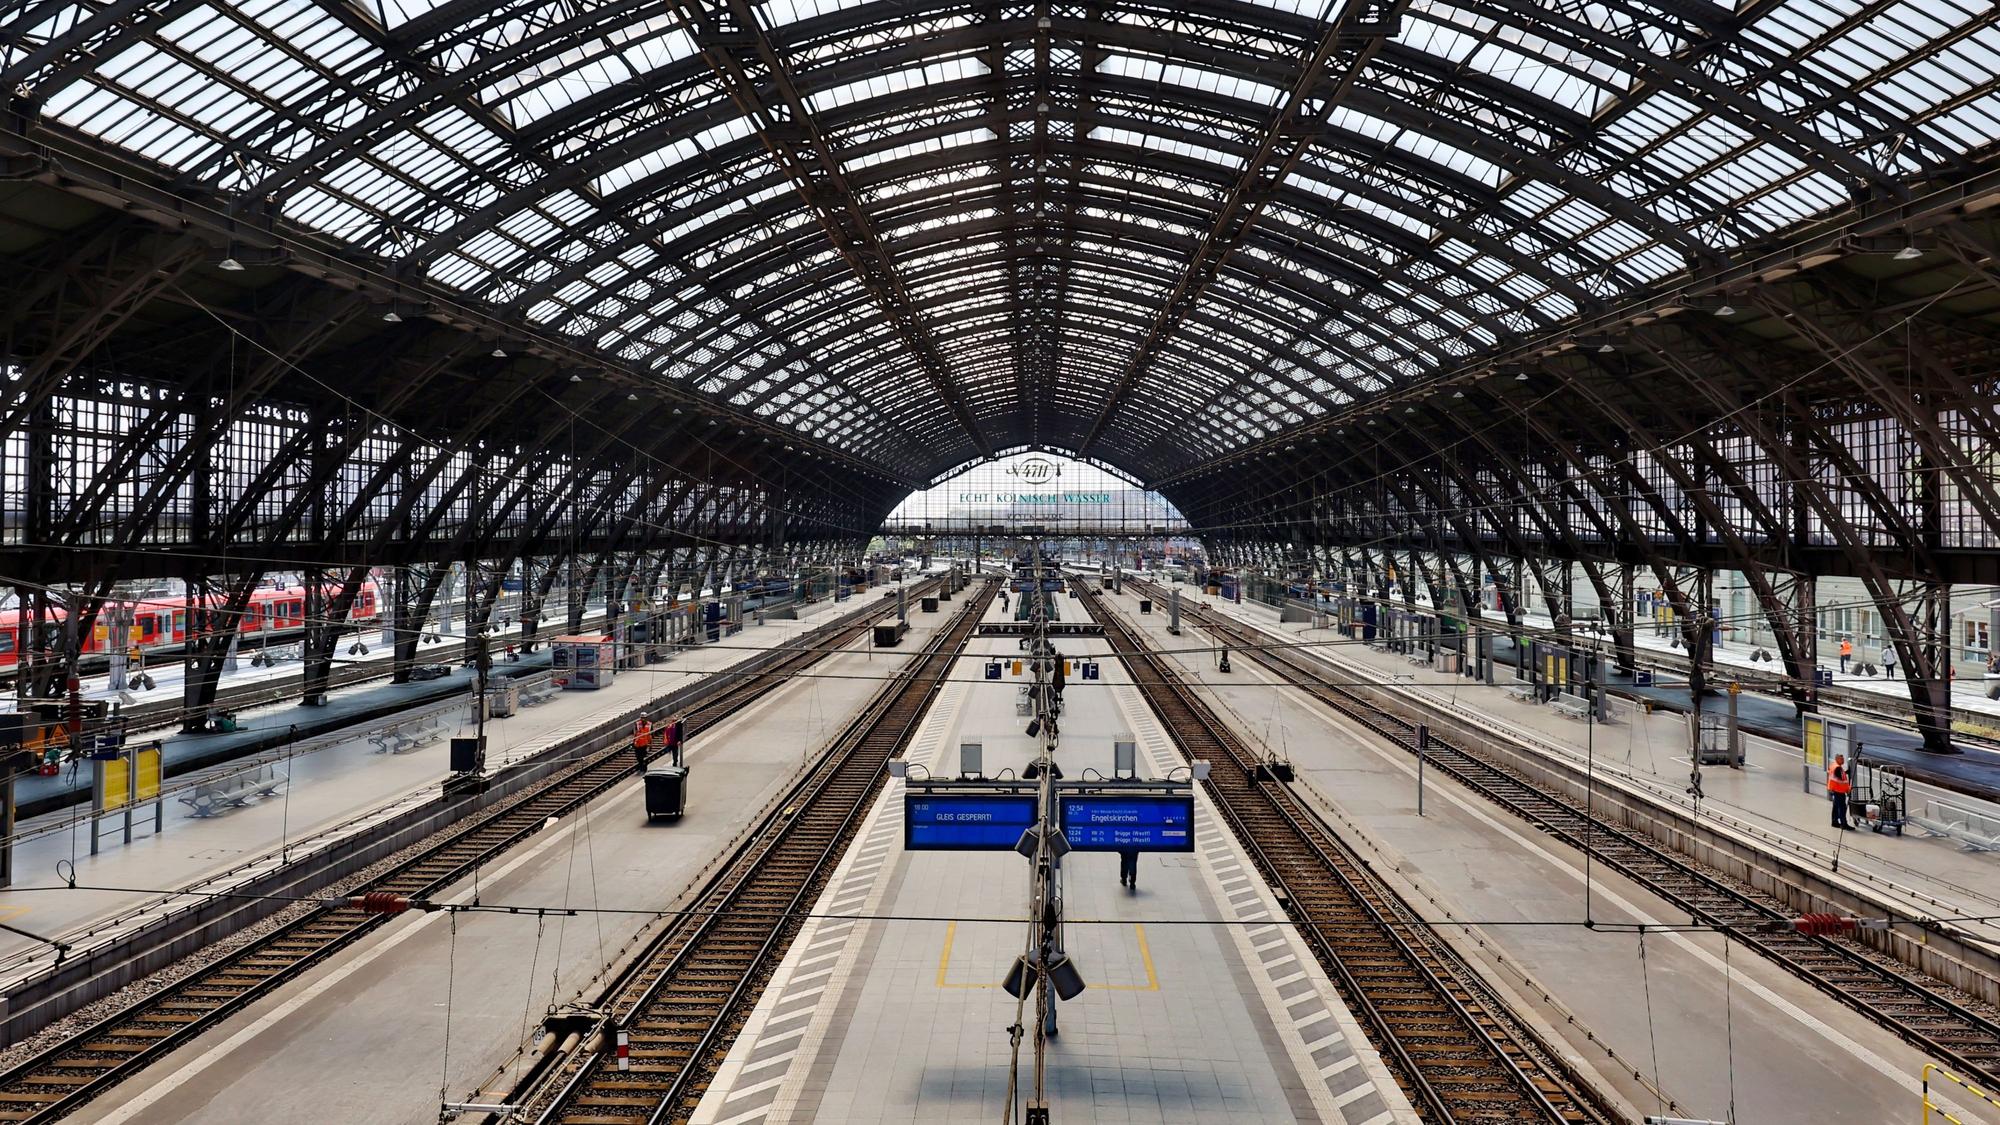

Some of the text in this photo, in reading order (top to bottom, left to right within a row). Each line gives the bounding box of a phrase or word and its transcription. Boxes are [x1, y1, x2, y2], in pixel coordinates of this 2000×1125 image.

[1022, 464, 1049, 478] 4711
[960, 491, 1110, 503] ECHT KÖLNISCH WASSER
[987, 664, 995, 676] F
[1088, 664, 1097, 676] F
[1823, 671, 1831, 684] F
[94, 735, 107, 754] F
[936, 813, 954, 821] GLEIS
[1091, 814, 1138, 823] Engelskirchen
